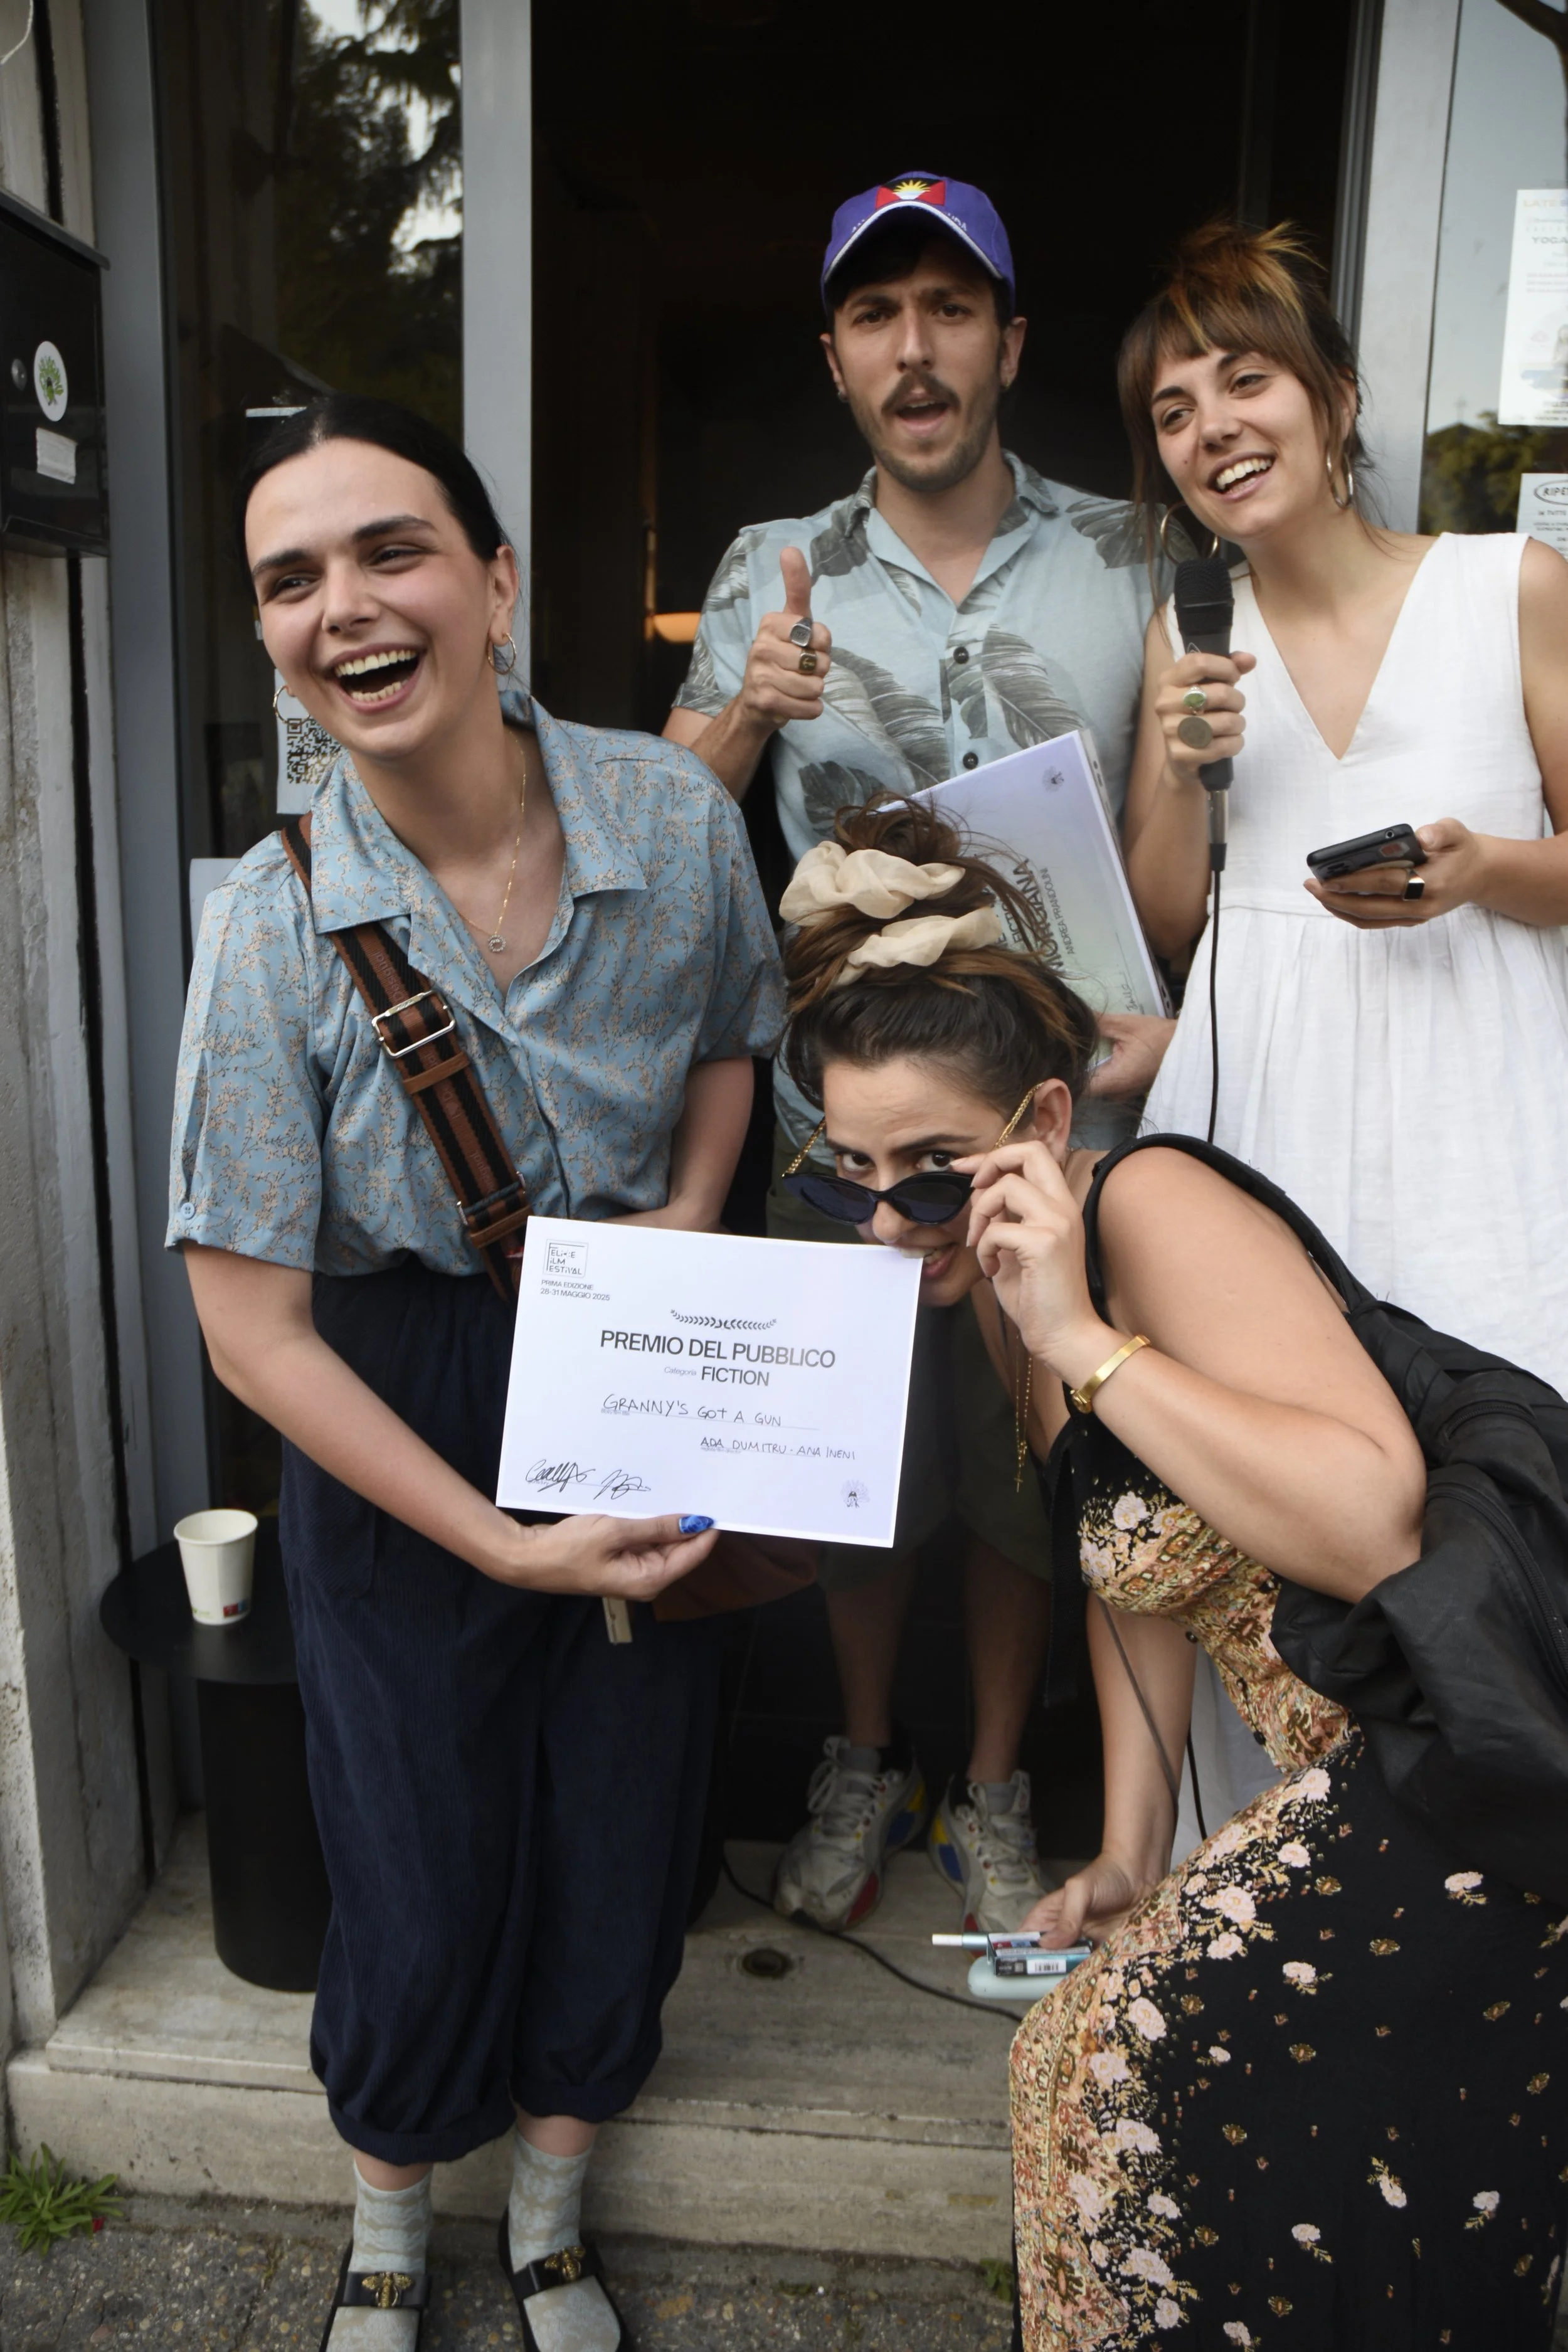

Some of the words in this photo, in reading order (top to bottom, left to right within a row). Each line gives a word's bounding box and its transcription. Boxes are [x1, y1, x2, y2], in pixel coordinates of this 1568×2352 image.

[540, 1288, 559, 1296] 28-31
[561, 1290, 591, 1299] MAGGIO
[592, 1293, 610, 1301] 2025
[563, 1282, 594, 1291] EDIZIONE
[600, 1330, 684, 1355] PREMIO
[689, 1338, 728, 1360] DEL
[732, 1342, 836, 1368] PUBBLICO
[664, 1365, 697, 1377] Categoria
[701, 1365, 770, 1387] FICTION
[603, 1394, 689, 1417] GRANNY'S
[733, 1410, 744, 1423] A
[755, 1412, 781, 1427] GUN
[700, 1436, 724, 1449] ADA
[733, 1439, 787, 1454] DUMITRU
[797, 1445, 821, 1458] ANA
